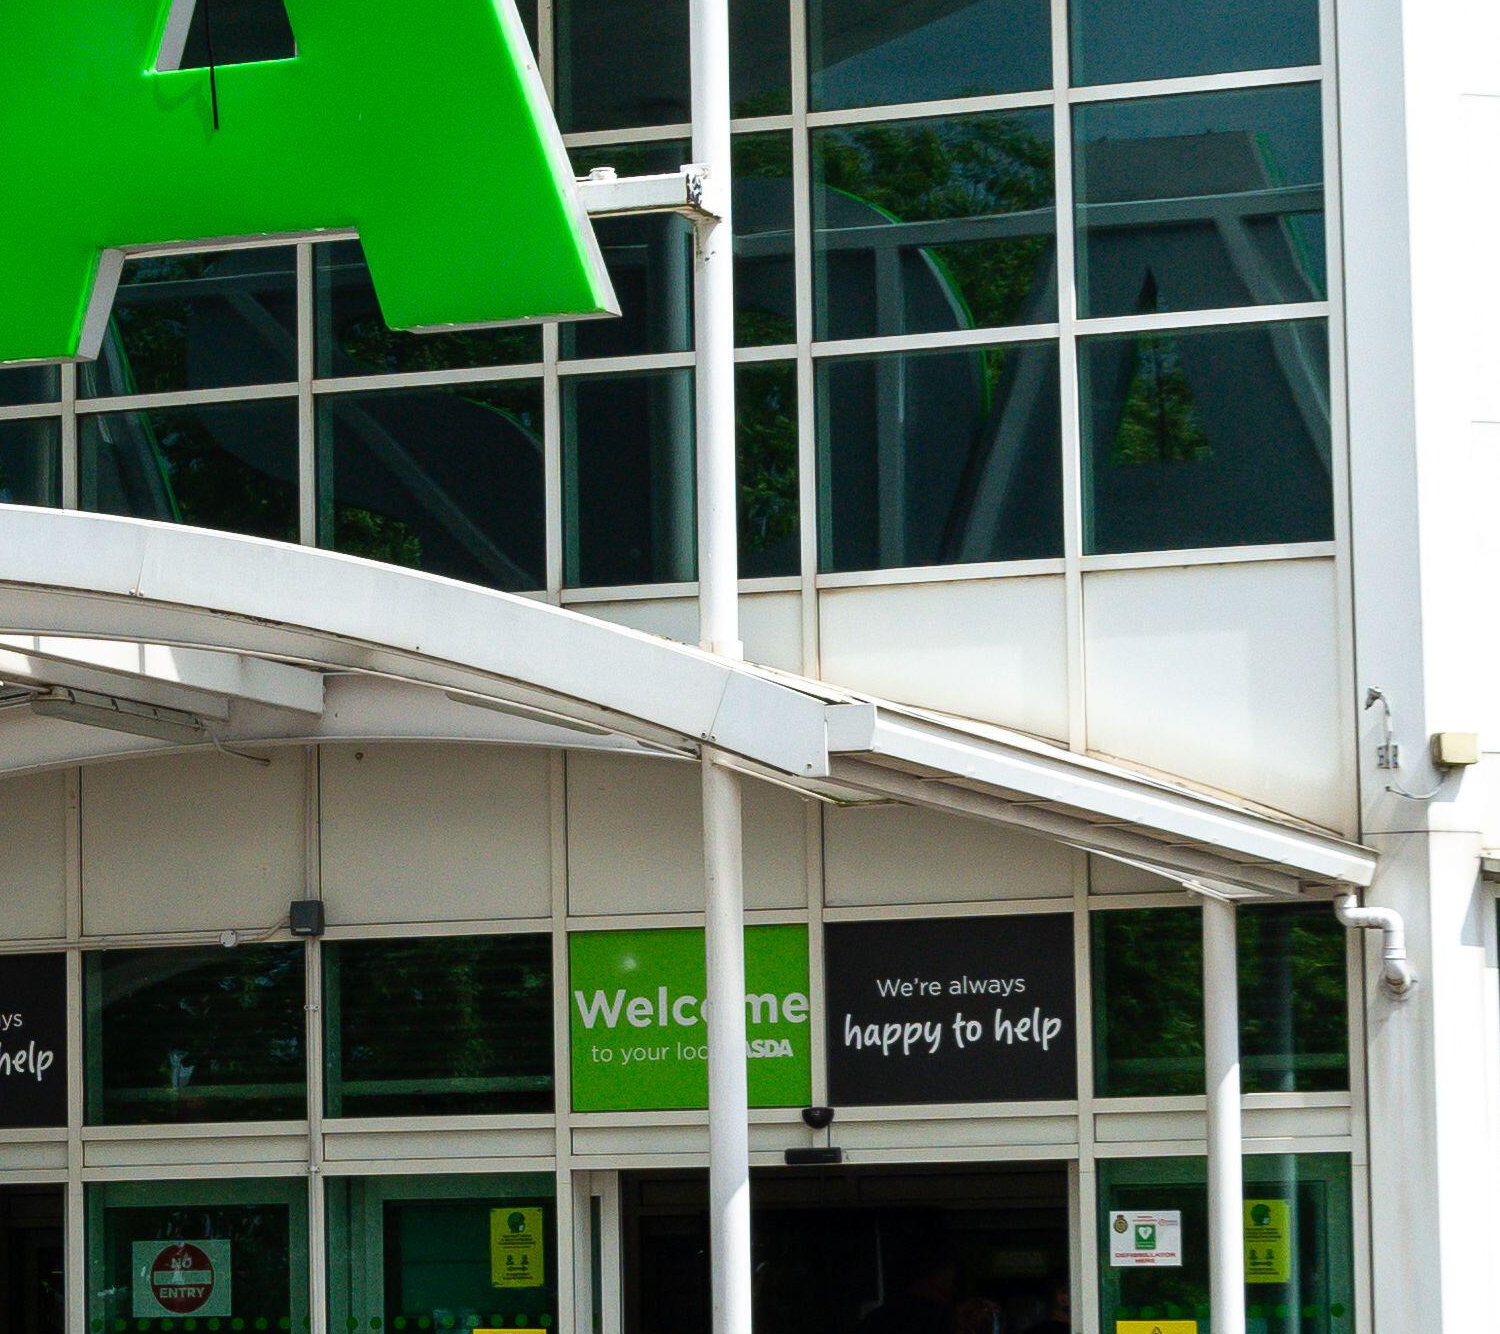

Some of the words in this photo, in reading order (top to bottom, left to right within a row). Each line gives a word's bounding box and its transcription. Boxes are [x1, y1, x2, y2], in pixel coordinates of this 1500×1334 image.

[949, 976, 1026, 998] always
[574, 986, 810, 1029] Welcme
[844, 1012, 942, 1055] happy
[951, 1013, 981, 1049] to
[993, 1007, 1062, 1051] help
[592, 1044, 613, 1063] to
[620, 1044, 667, 1065] your
[676, 1041, 709, 1061] loc
[171, 1257, 193, 1269] NO
[160, 1287, 205, 1299] ENTRY
